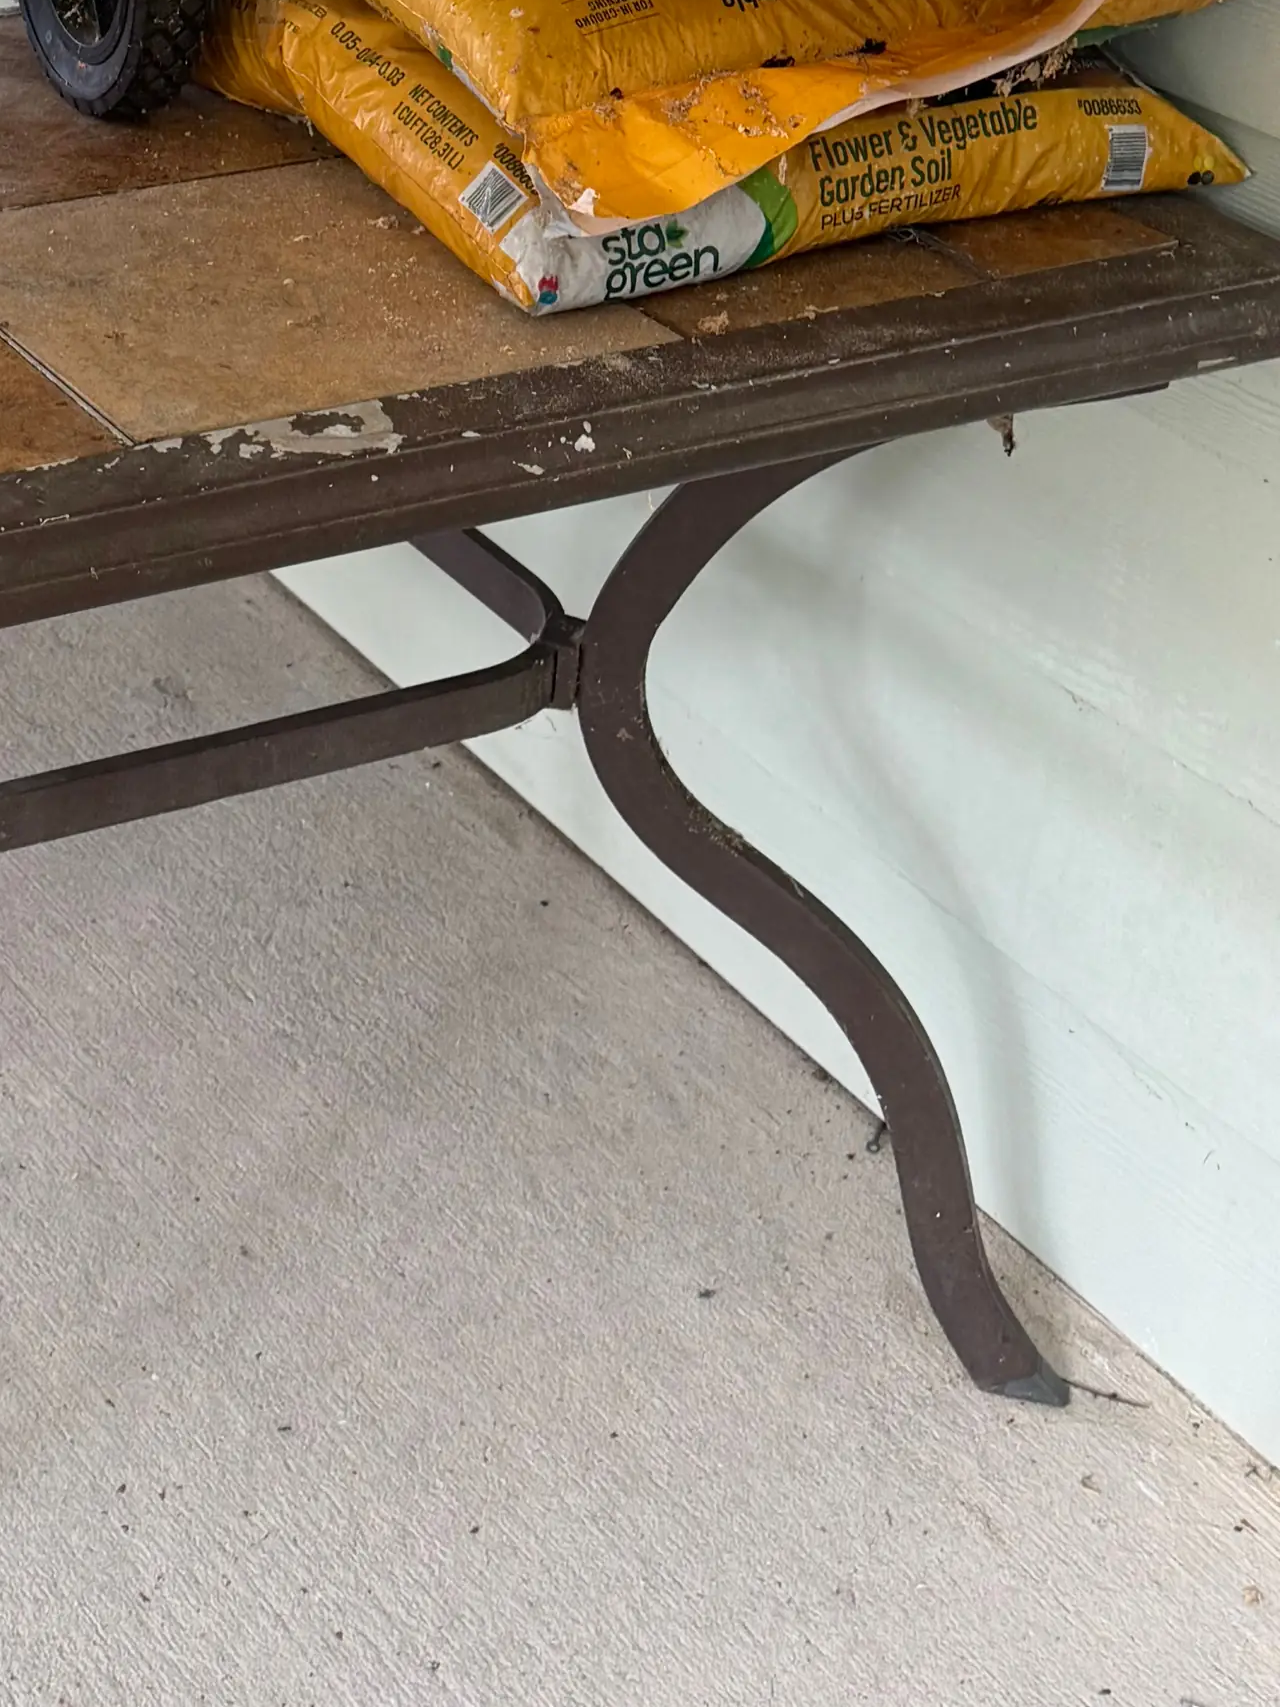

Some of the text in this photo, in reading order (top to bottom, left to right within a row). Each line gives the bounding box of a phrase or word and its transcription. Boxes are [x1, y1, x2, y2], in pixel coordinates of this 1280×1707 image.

[574, 2, 633, 29] IN-GROUND
[408, 83, 480, 147] NET CONTENTS
[809, 99, 1038, 172] Flower & Vegetable
[819, 148, 952, 207] Garden Soil
[821, 184, 961, 230] PLUS FERTILIZER
[601, 223, 666, 266] sta
[604, 245, 720, 301] green
